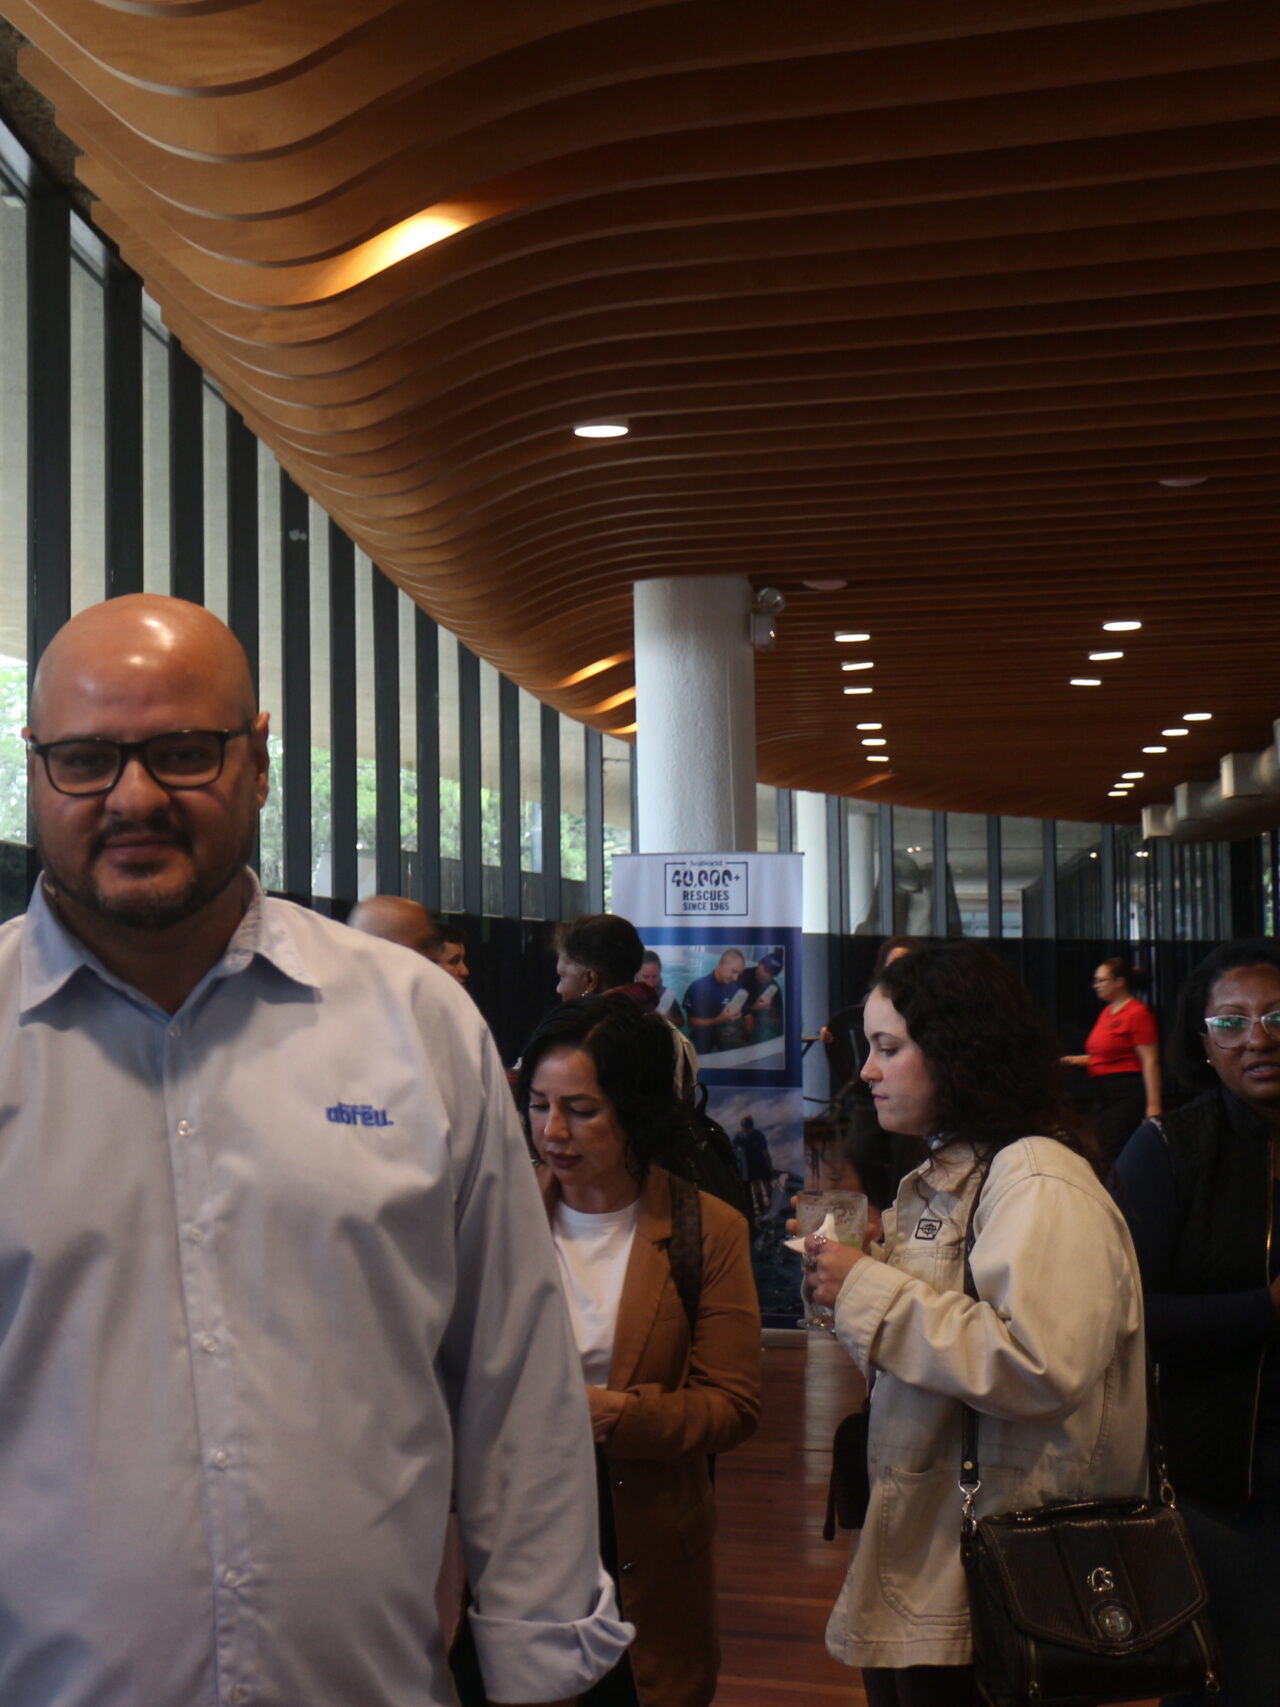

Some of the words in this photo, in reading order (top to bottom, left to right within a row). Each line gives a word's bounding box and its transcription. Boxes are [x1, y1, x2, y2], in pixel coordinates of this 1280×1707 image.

[682, 890, 730, 901] RESCUES
[682, 902, 707, 911] SINCE
[709, 902, 730, 911] 1965
